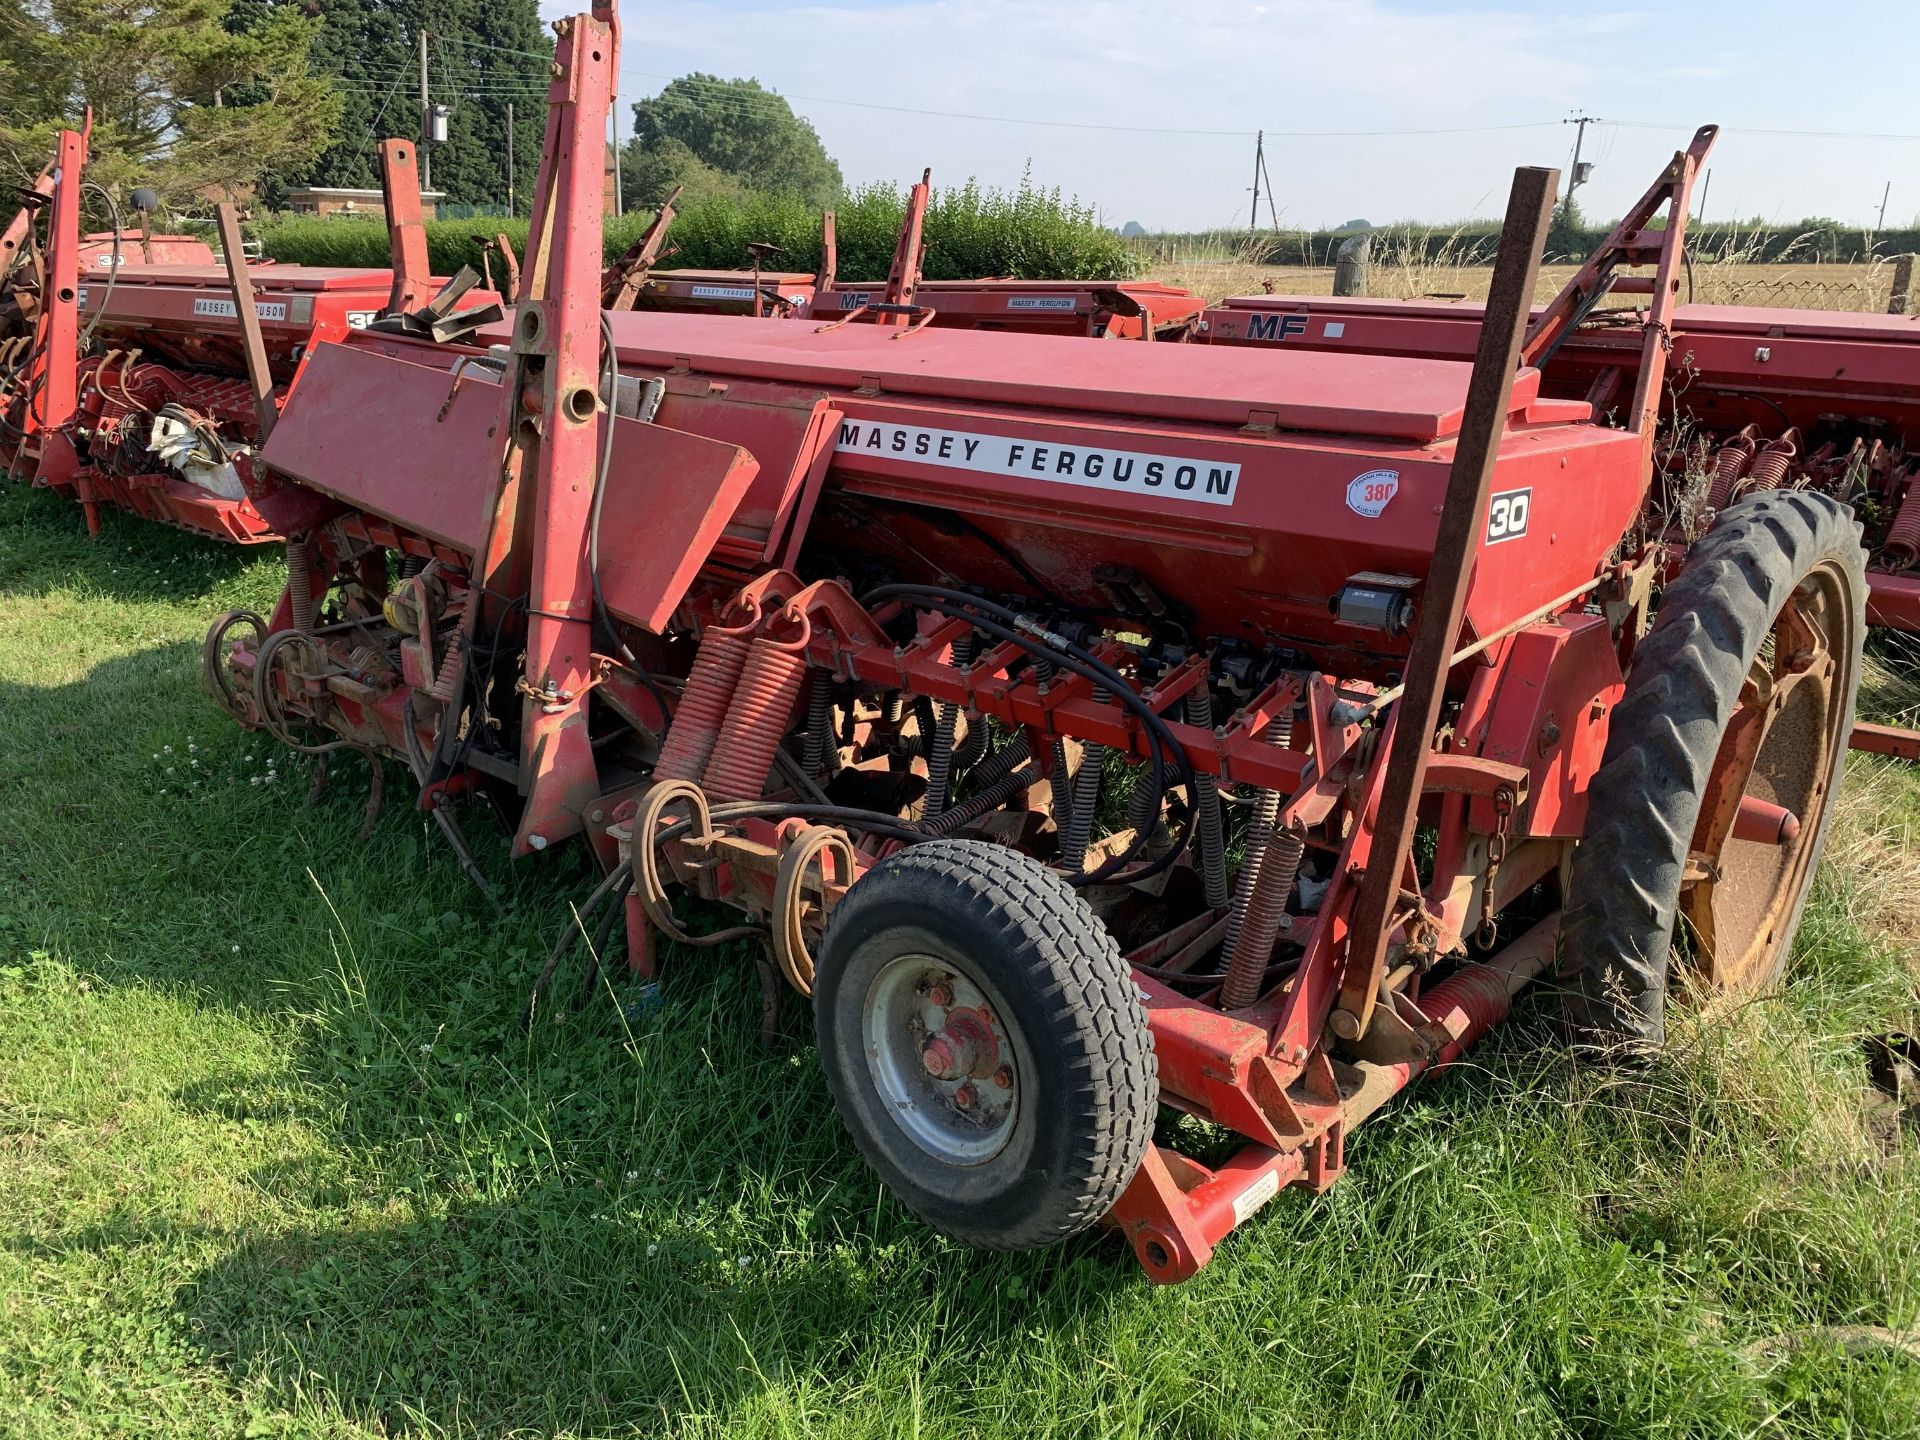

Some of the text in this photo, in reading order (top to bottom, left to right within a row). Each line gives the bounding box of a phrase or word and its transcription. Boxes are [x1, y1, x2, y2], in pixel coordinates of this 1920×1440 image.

[690, 287, 756, 297] MASSEY FERGUSO
[195, 301, 231, 314] MASSEY
[840, 293, 869, 310] MF
[1246, 314, 1309, 340] MF
[838, 423, 1233, 495] MASSEY FERGUSON
[1365, 483, 1394, 502] 380
[1355, 505, 1379, 515] AUCTIO
[1490, 495, 1529, 537] 30
